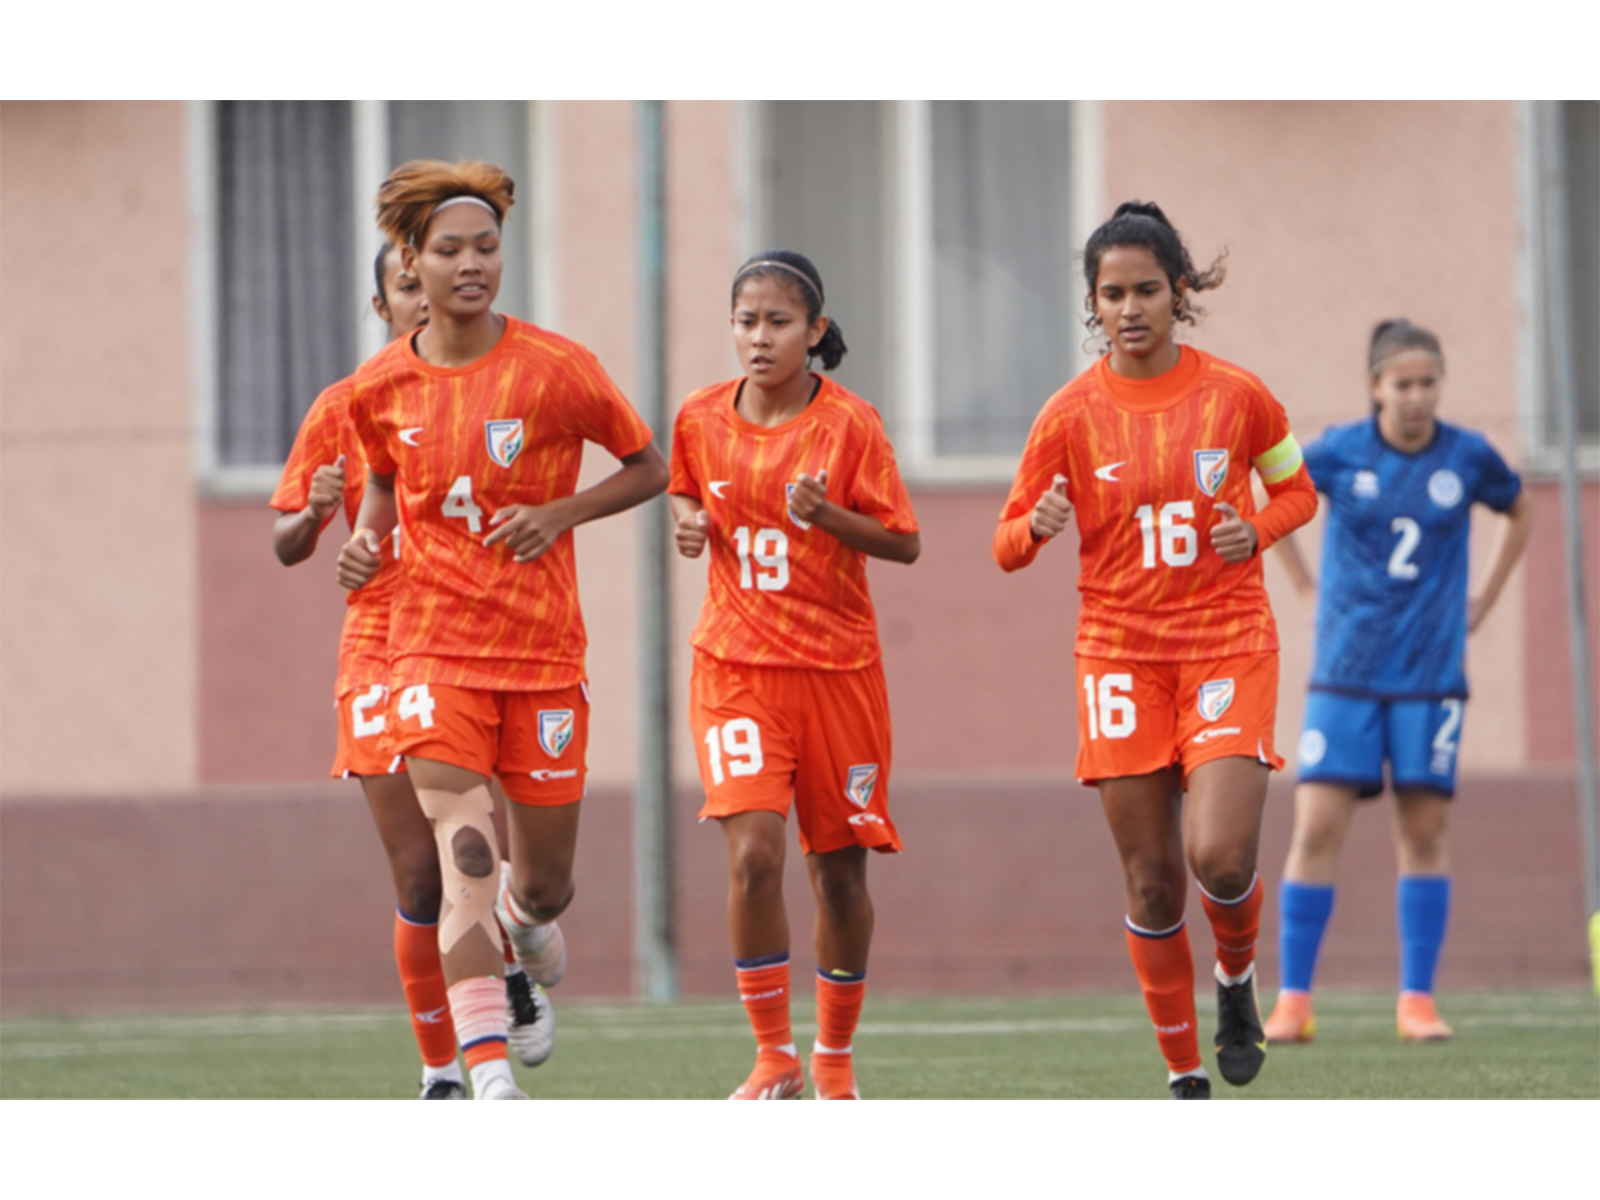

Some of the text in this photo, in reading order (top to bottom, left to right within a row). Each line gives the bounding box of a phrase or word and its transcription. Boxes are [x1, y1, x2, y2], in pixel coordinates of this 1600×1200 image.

[441, 475, 483, 533] 4
[1134, 500, 1198, 569] 16
[733, 526, 790, 591] 19
[1387, 516, 1422, 580] 2
[352, 683, 385, 739] 2
[397, 683, 436, 730] 4
[1083, 672, 1136, 741] 16
[1432, 698, 1462, 752] 2
[704, 717, 764, 786] 19
